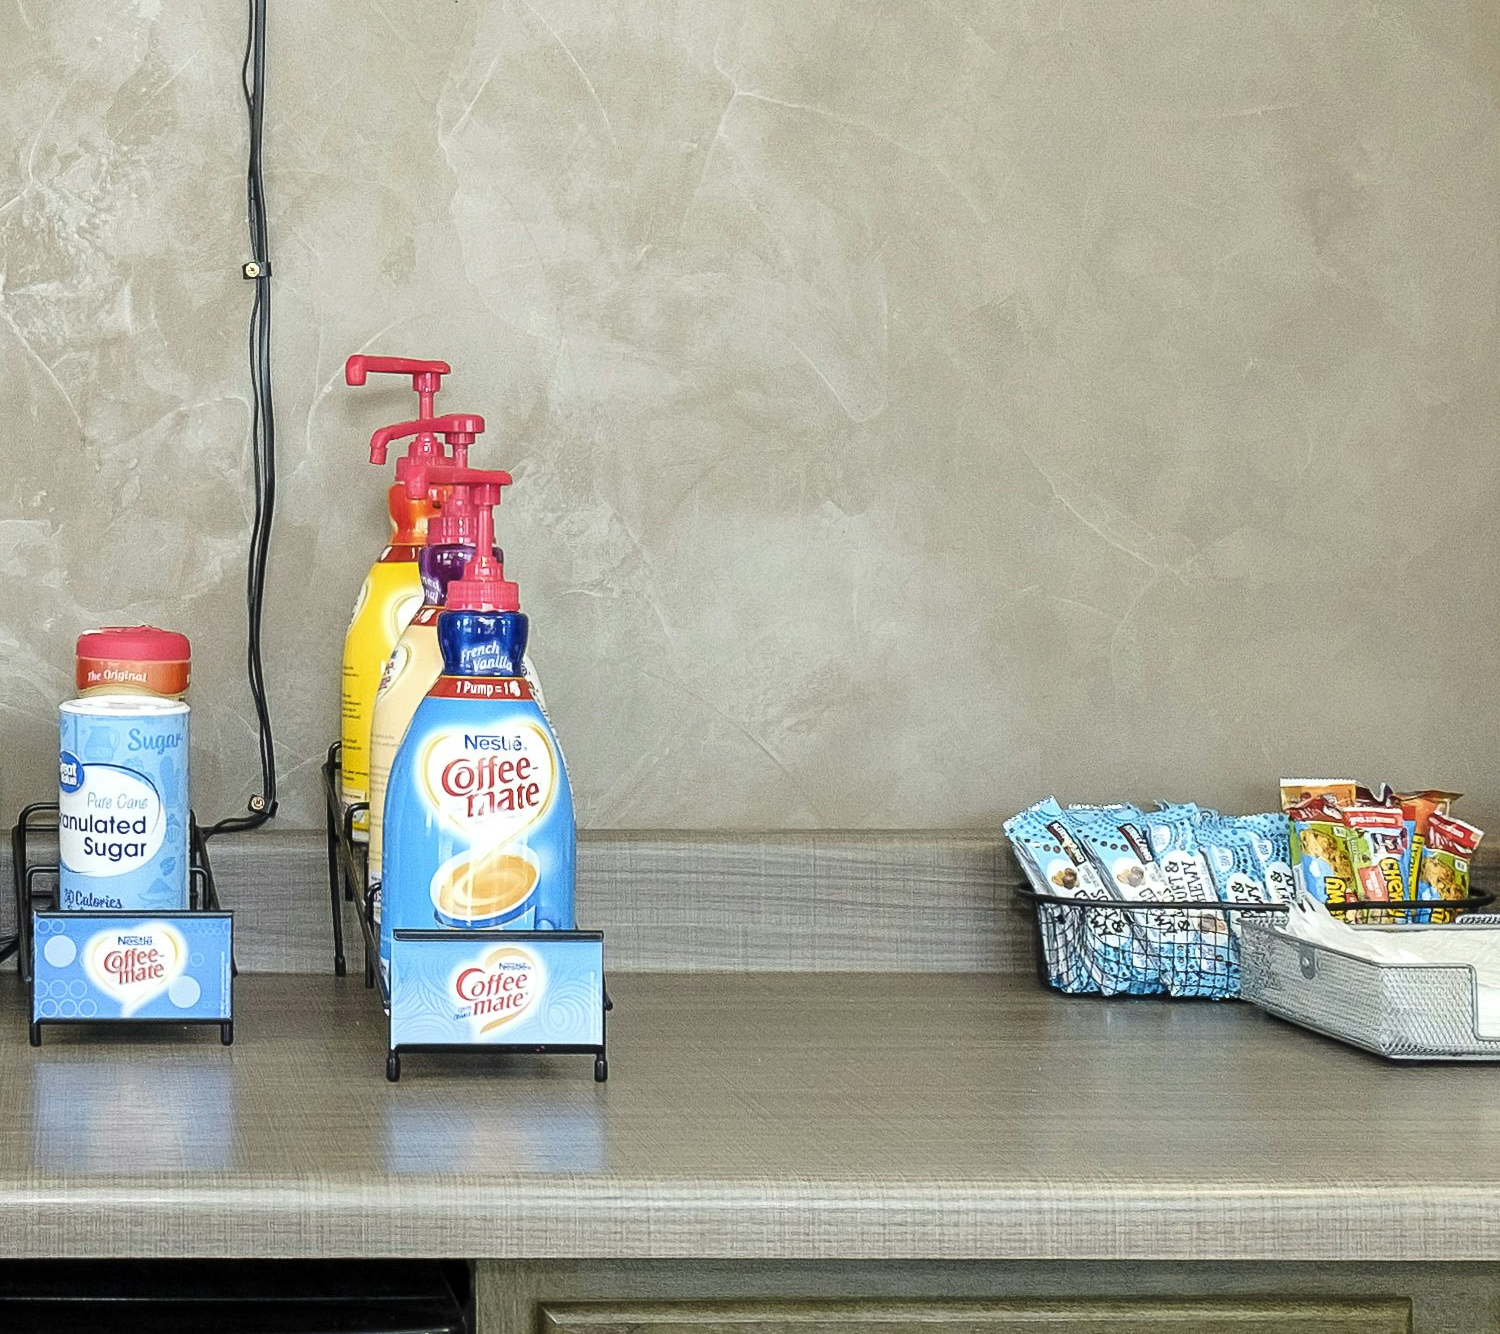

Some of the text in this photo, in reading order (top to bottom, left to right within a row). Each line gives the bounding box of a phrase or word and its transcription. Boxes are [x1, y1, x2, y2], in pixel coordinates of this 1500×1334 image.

[461, 641, 500, 663] French
[473, 654, 513, 673] Vanilla
[87, 669, 147, 683] The Original
[456, 682, 462, 694] 1
[463, 682, 493, 697] Pump
[127, 728, 183, 755] Sugar
[464, 734, 523, 751] Nestlé
[441, 755, 539, 797] Coffee-
[87, 792, 148, 810] Pure Cane
[467, 781, 540, 818] mate
[60, 815, 147, 834] ranulated
[83, 836, 147, 862] Sugar
[75, 890, 123, 909] Calories
[119, 962, 165, 985] mate
[456, 968, 529, 1002] Coffee
[473, 991, 525, 1016] mate
